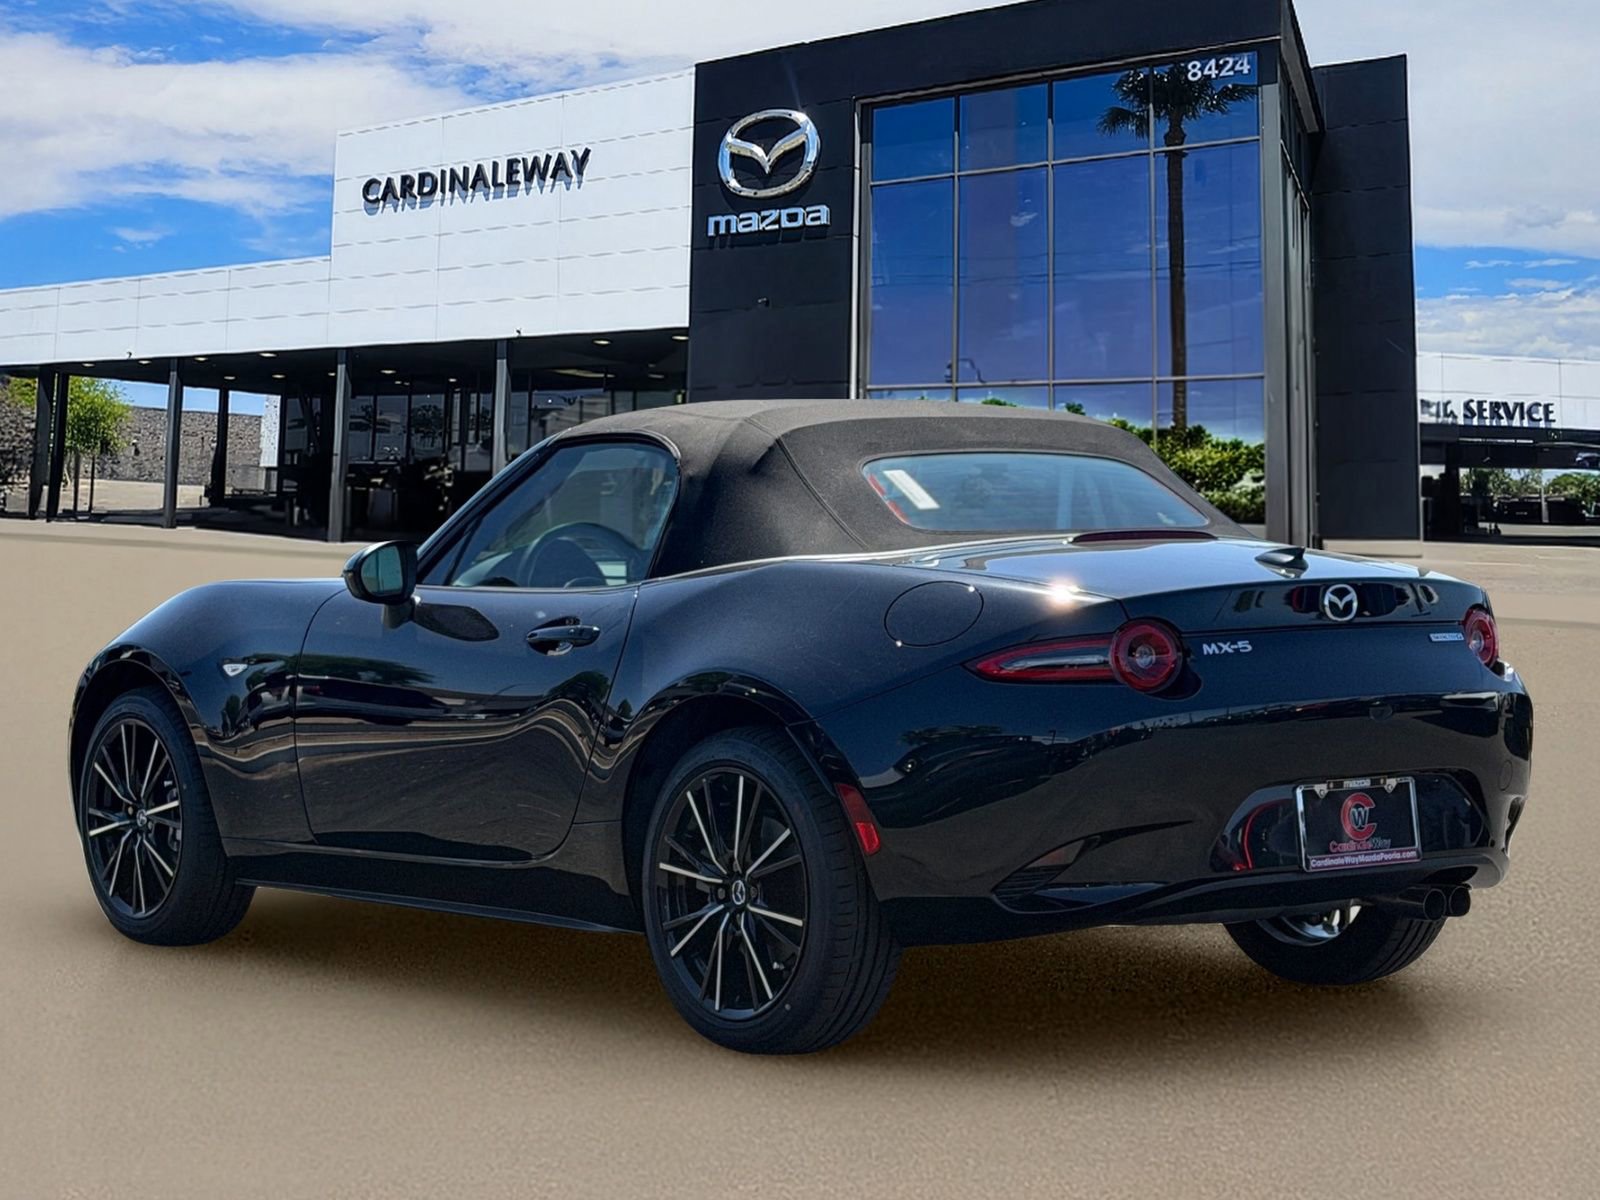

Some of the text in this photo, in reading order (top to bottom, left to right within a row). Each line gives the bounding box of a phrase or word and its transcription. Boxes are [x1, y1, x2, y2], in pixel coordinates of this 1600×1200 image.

[1187, 55, 1251, 81] 8424
[362, 147, 592, 204] CARDINALEWAY
[707, 204, 830, 237] mazda
[1463, 398, 1556, 423] SERVICE
[1202, 640, 1253, 656] MX-5
